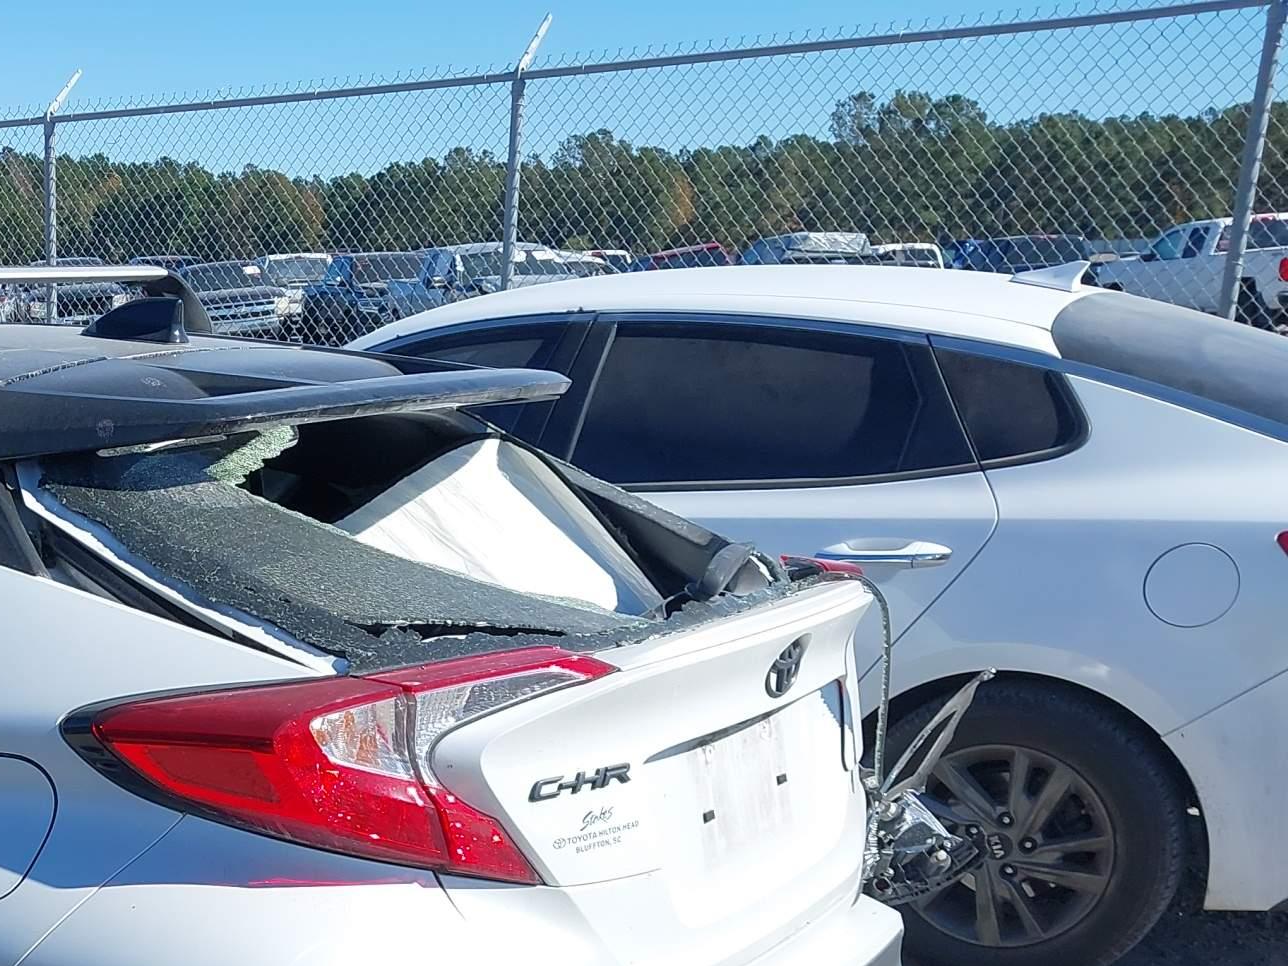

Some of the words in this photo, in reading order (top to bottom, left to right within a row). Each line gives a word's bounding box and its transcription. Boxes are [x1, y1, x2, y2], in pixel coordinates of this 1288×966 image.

[528, 762, 631, 803] C-HR
[567, 831, 598, 844] TOYOTA
[598, 825, 621, 836] HILTON
[622, 820, 639, 831] HEAD
[613, 836, 622, 845] SC
[988, 835, 1005, 858] KIA
